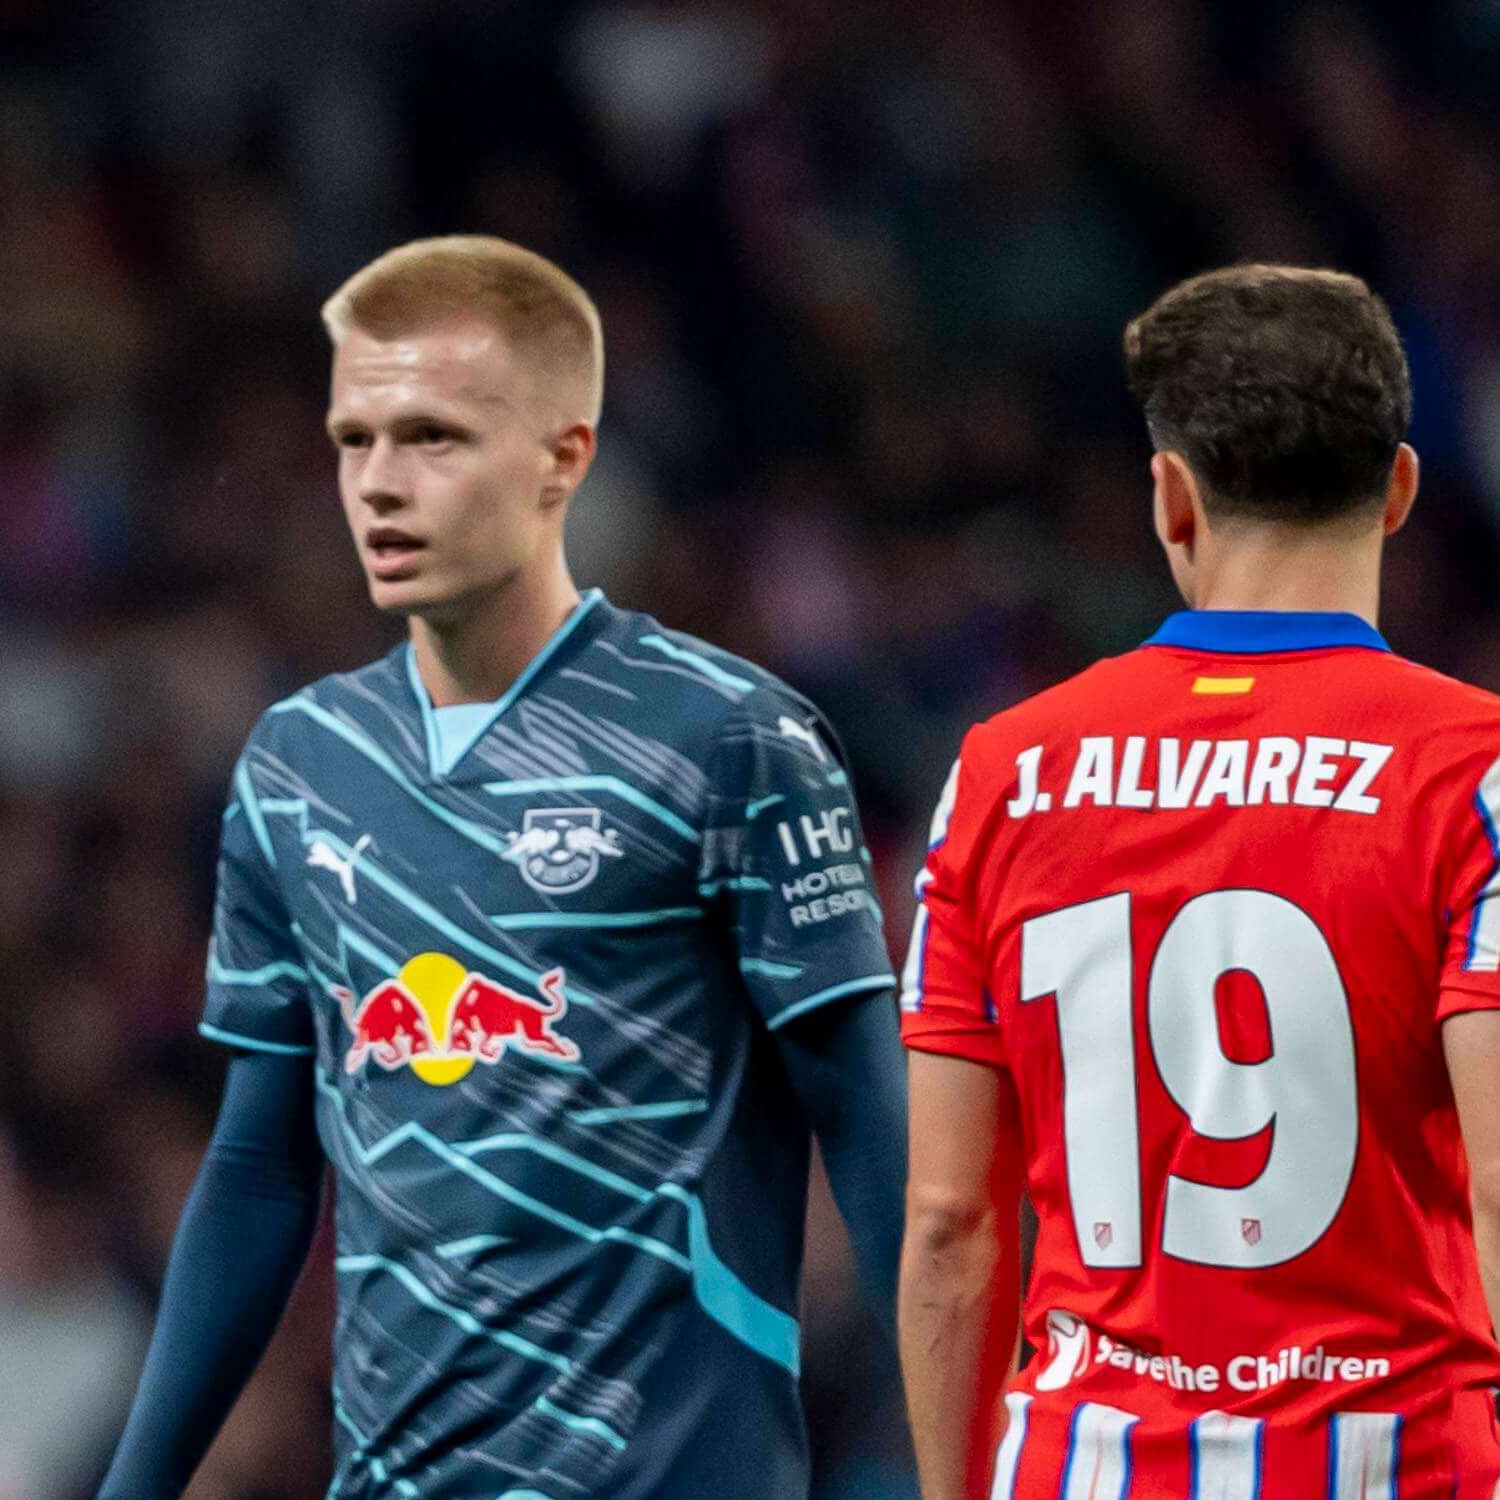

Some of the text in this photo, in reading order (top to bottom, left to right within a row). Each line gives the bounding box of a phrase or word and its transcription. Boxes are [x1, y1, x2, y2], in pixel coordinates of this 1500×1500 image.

[1007, 736, 1396, 819] J. ALVAREZ
[1020, 888, 1360, 1270] 19
[1227, 1346, 1391, 1392] Children
